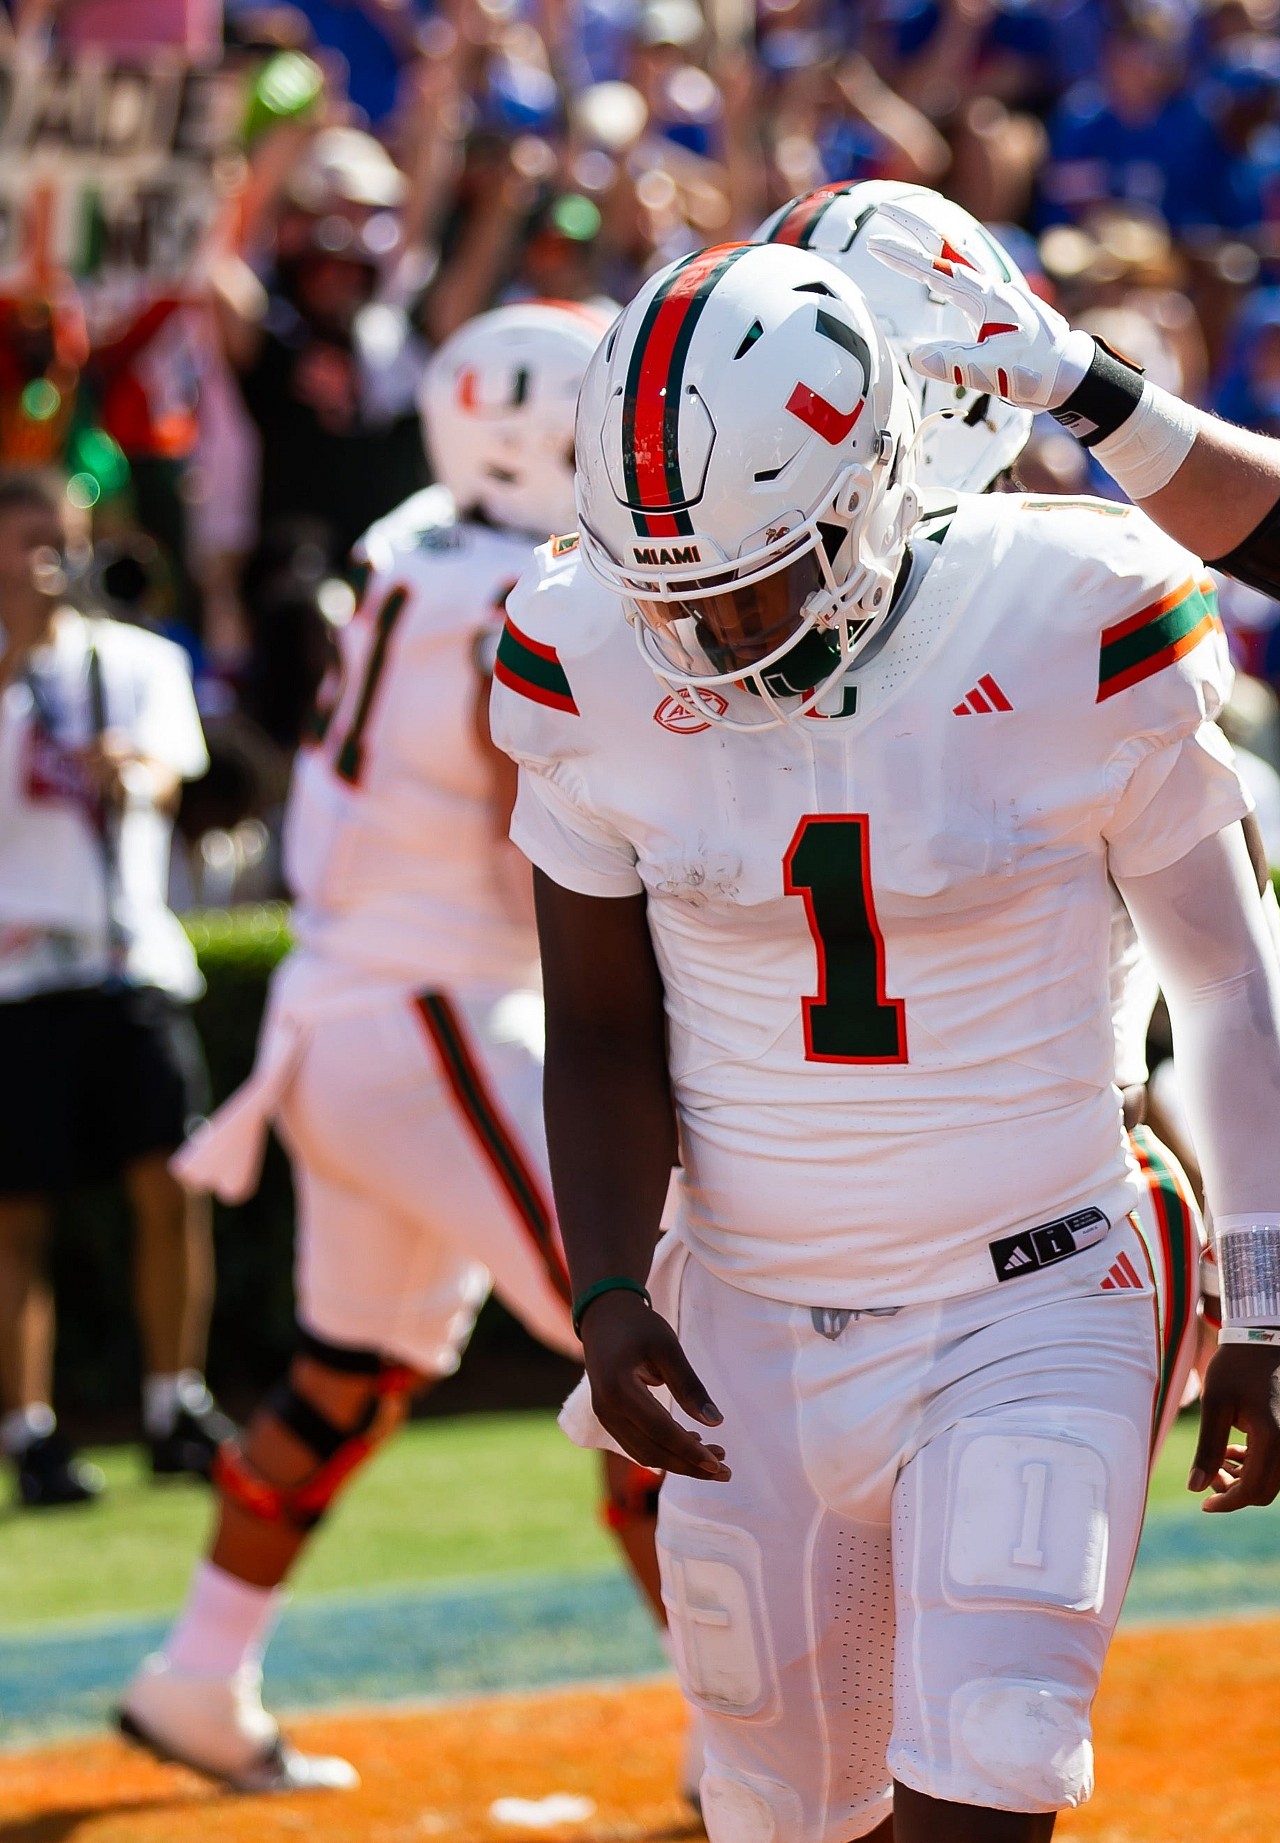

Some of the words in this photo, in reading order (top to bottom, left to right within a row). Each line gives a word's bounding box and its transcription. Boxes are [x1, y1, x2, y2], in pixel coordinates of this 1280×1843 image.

[784, 307, 873, 446] U
[632, 545, 702, 566] MIAMI
[782, 813, 909, 1065] 1
